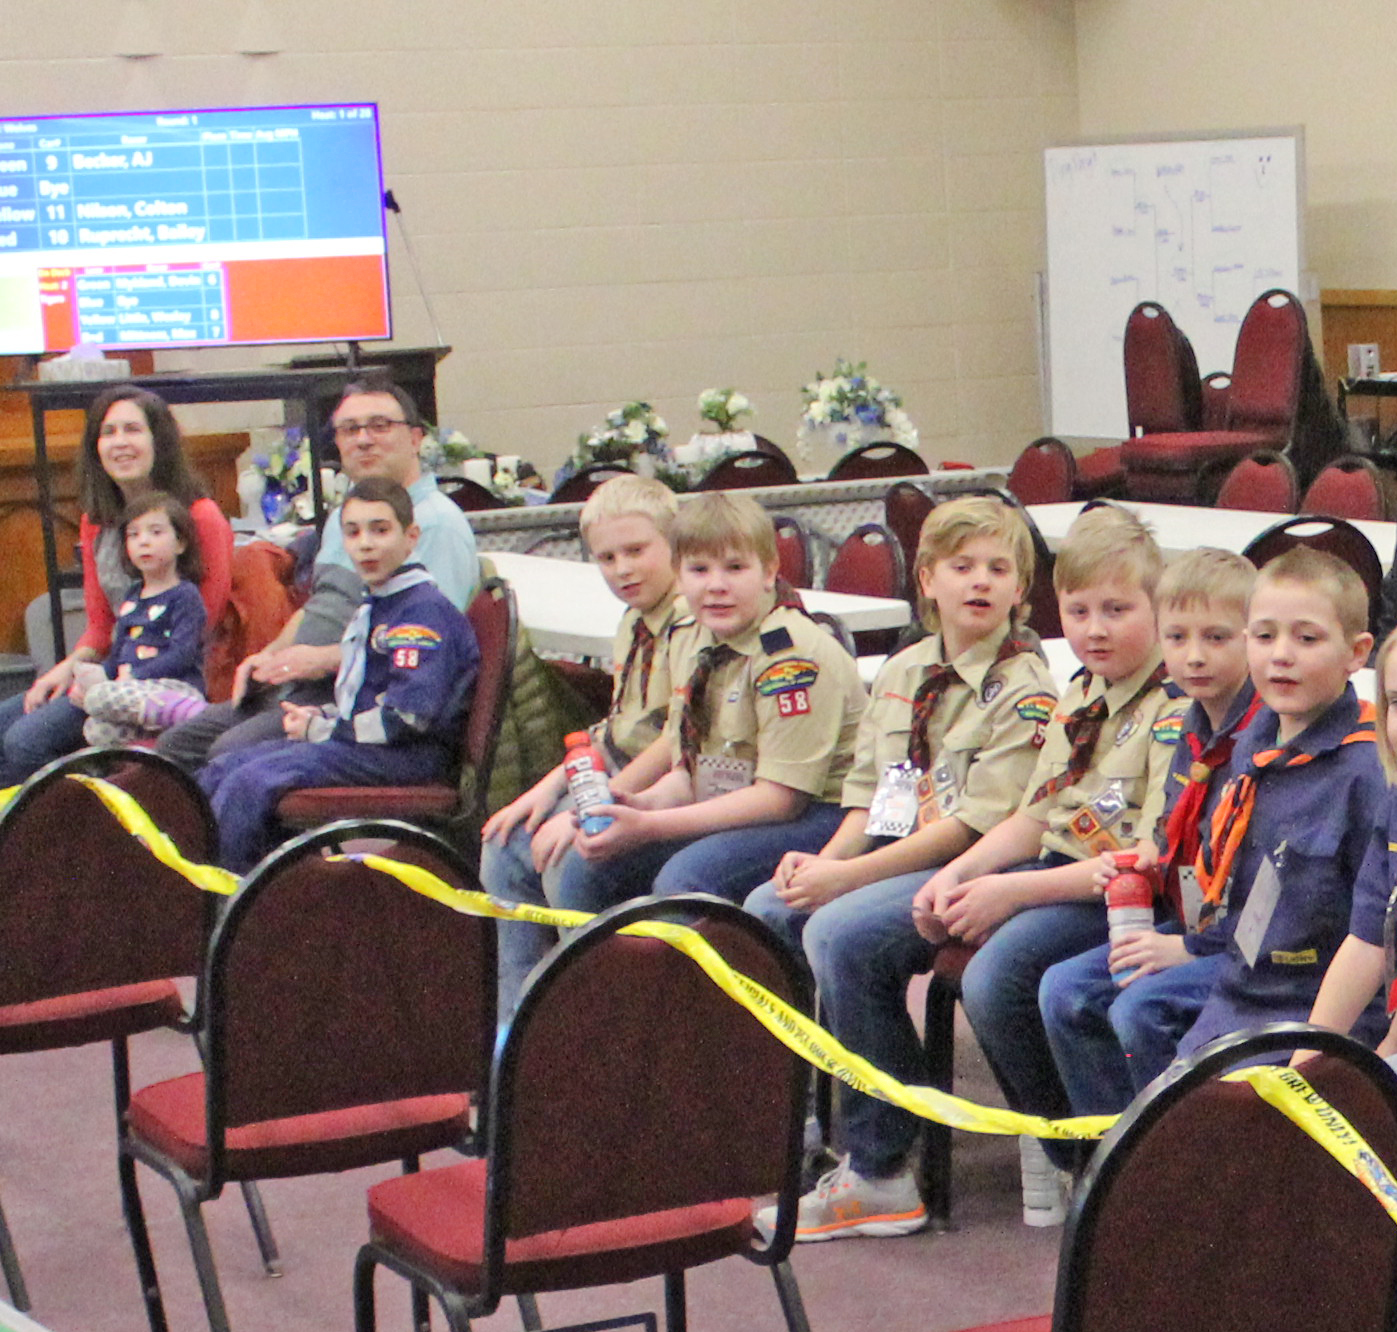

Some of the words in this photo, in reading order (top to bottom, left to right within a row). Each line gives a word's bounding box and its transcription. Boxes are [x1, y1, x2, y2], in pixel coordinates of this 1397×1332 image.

[131, 151, 153, 167] AJ
[47, 204, 65, 220] 11
[395, 650, 419, 667] 58
[779, 691, 808, 713] 58
[1279, 1071, 1323, 1105] CREW
